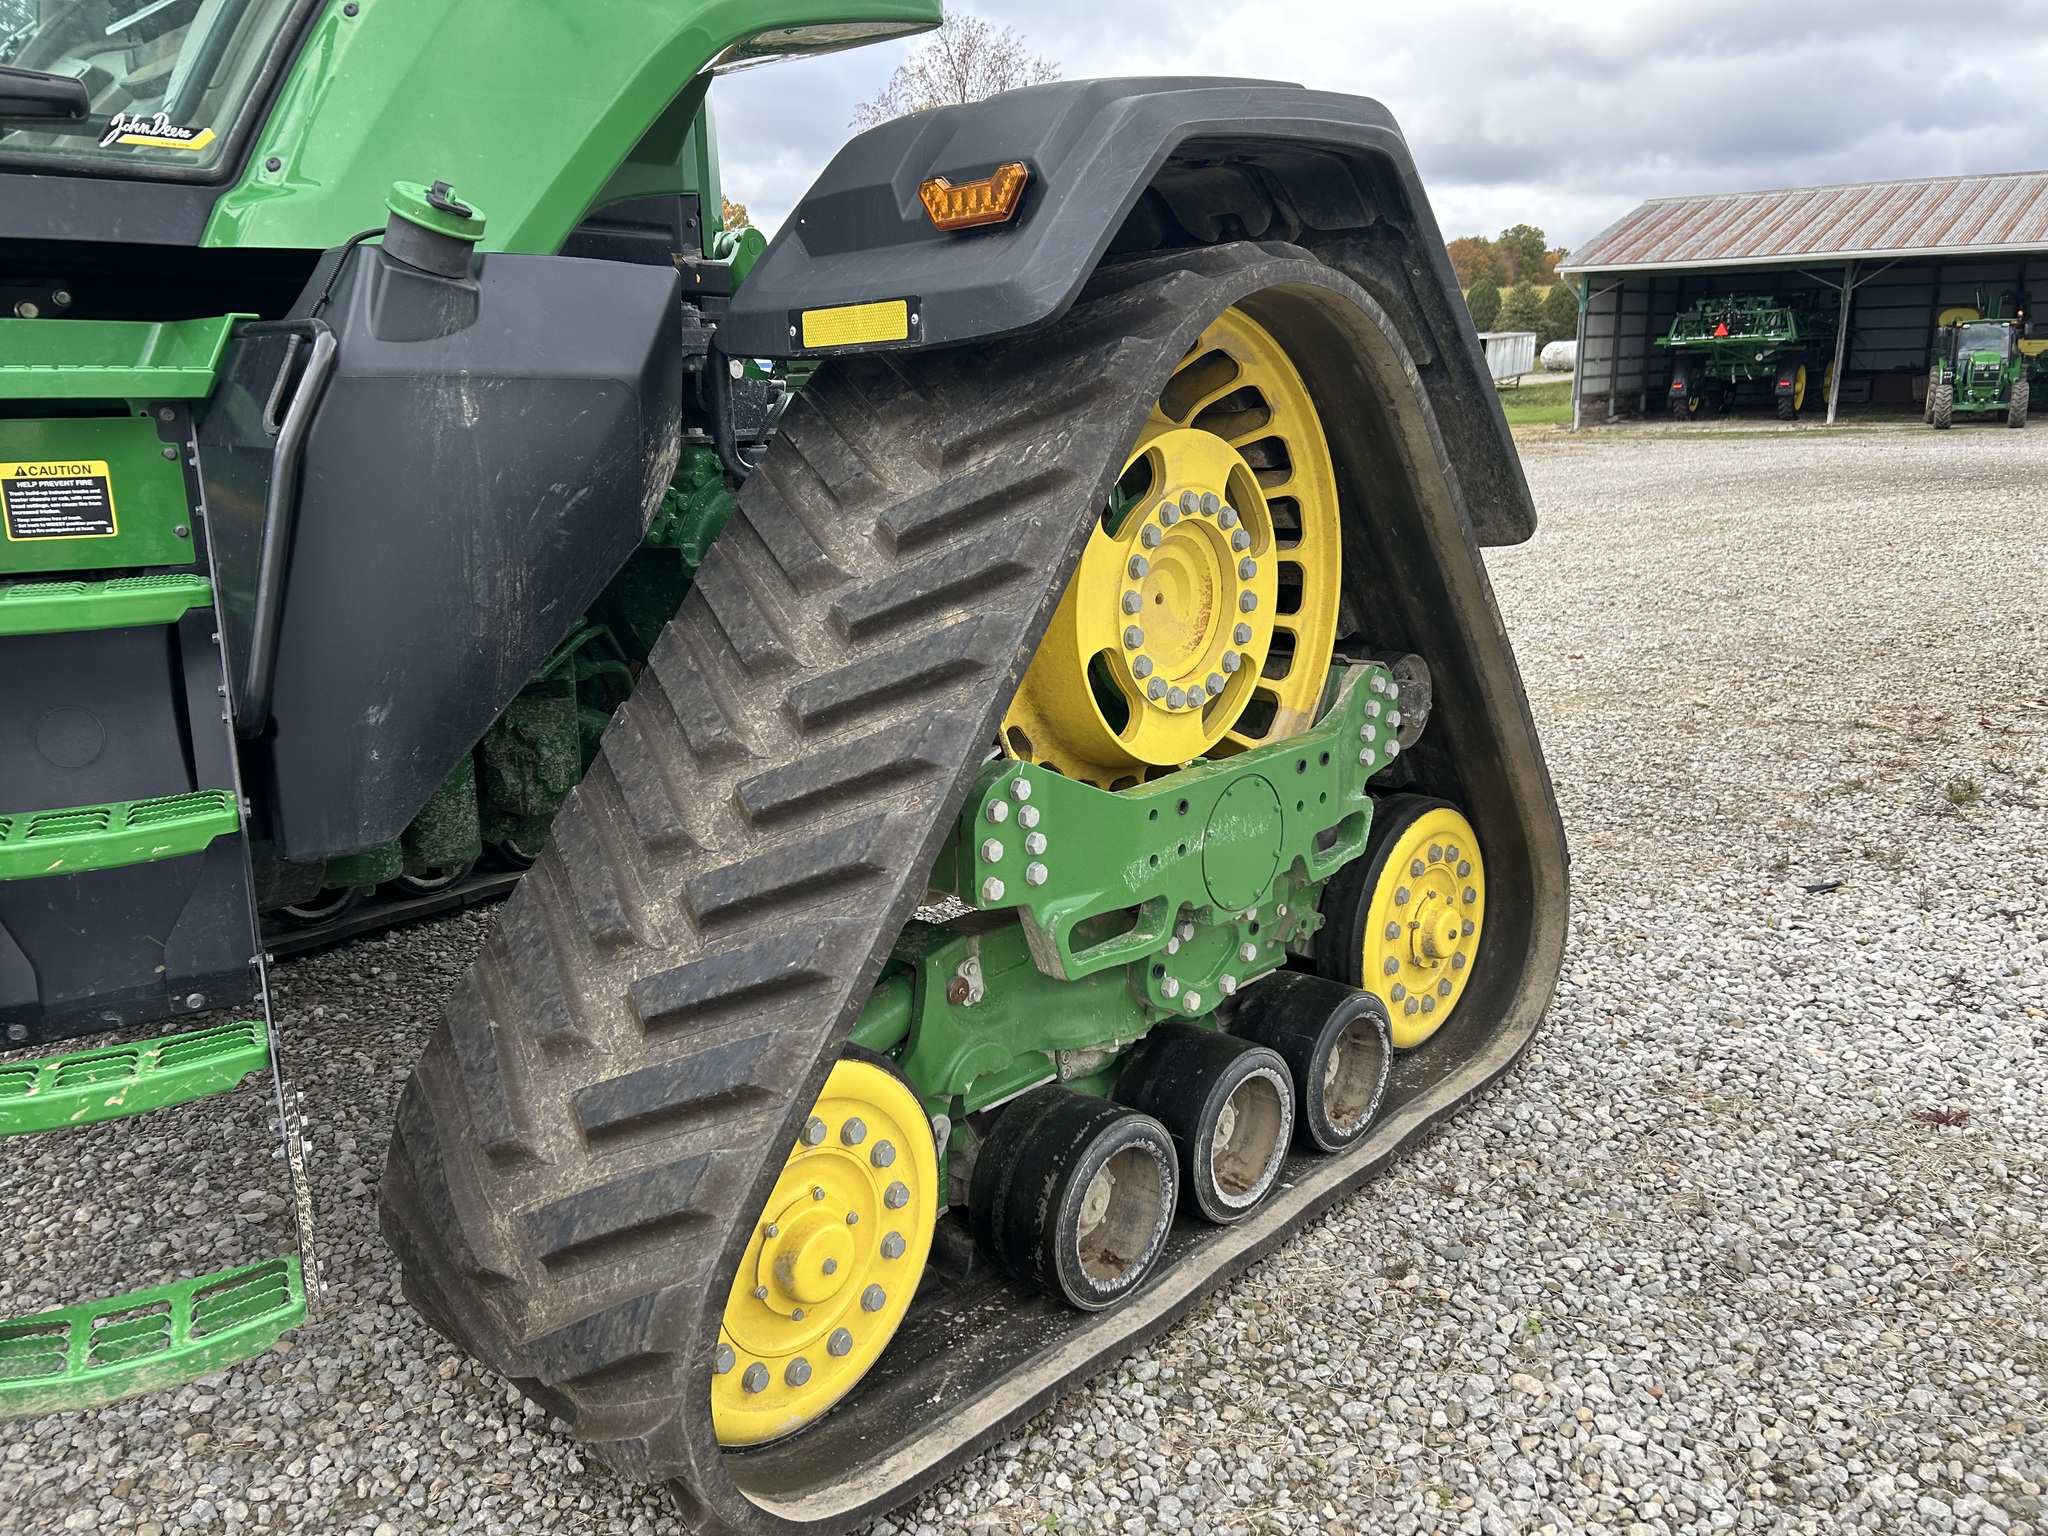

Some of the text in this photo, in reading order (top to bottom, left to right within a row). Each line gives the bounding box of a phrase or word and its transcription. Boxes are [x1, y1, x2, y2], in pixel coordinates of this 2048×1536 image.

[99, 112, 192, 148] John Deere
[29, 465, 91, 476] CAUTION
